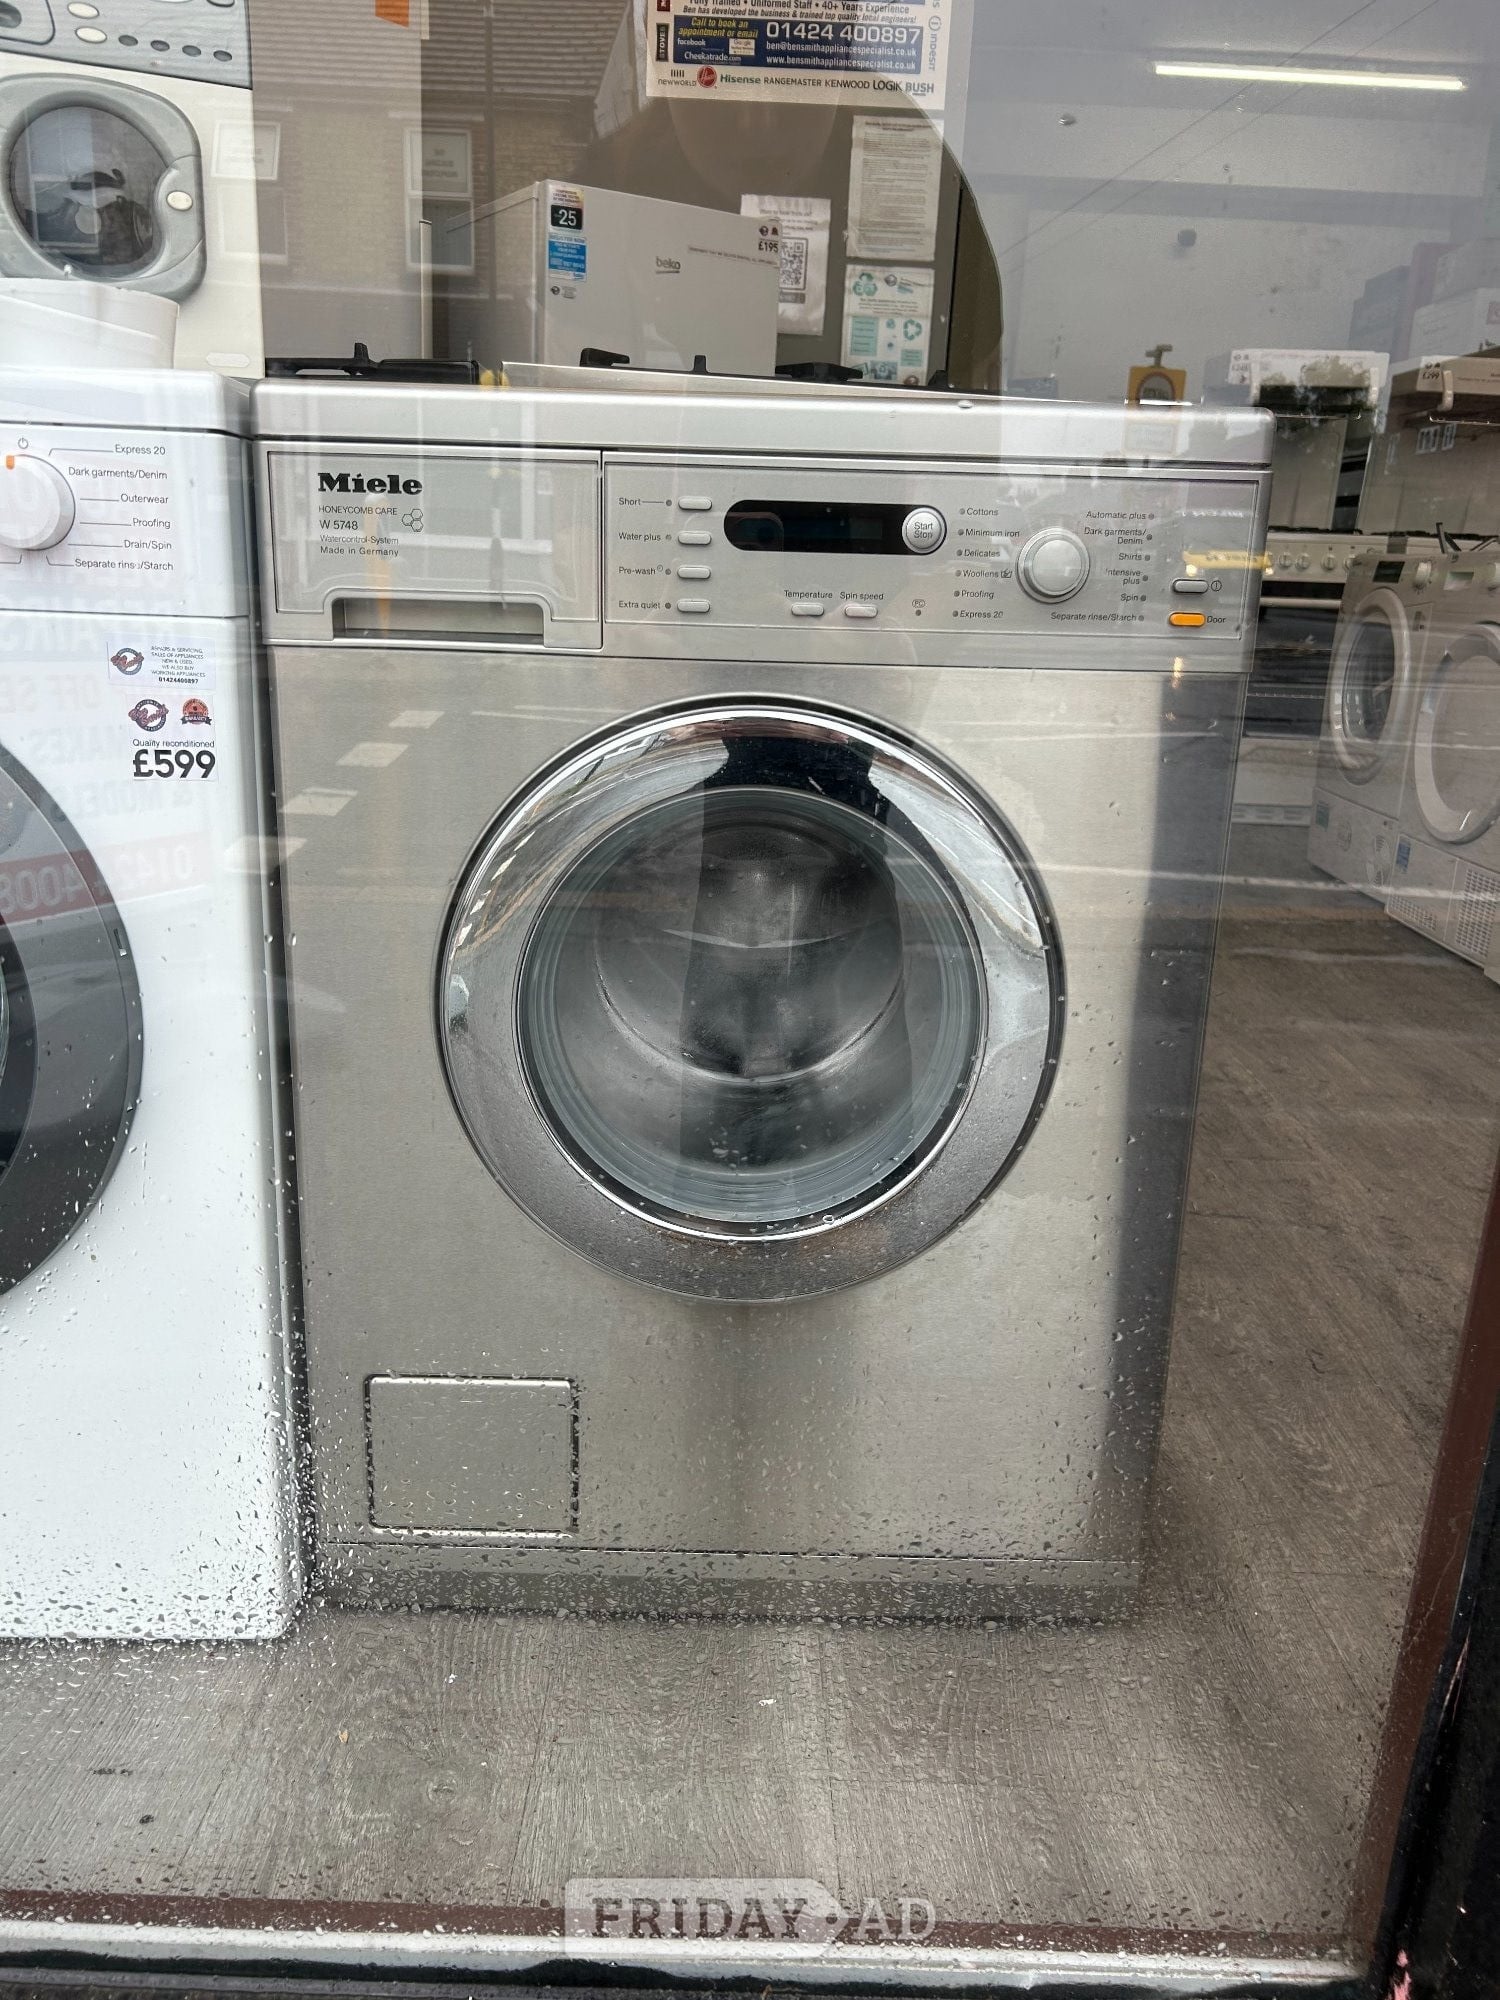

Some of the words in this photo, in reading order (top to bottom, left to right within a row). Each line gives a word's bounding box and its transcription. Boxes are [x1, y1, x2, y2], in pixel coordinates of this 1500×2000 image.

[751, 0, 791, 8] Uniformed
[794, 0, 812, 9] Staff
[822, 2, 838, 10] 40+
[842, 2, 863, 11] Years
[866, 4, 910, 14] Experience
[712, 7, 746, 16] developed
[760, 10, 790, 18] business
[800, 10, 824, 18] trained
[825, 12, 836, 20] top
[838, 12, 860, 22] quality
[691, 18, 706, 26] Call
[708, 18, 717, 26] to
[718, 19, 736, 28] book
[678, 27, 724, 36] appointment
[737, 29, 758, 38] email
[766, 22, 833, 40] 01424
[840, 24, 920, 44] 400897
[677, 38, 706, 46] facebook
[720, 74, 760, 84] Hisense
[764, 76, 822, 87] RANGEMASTER
[825, 79, 870, 89] KENWOOD
[873, 80, 902, 91] LOGIK
[906, 82, 934, 93] BUSH
[559, 209, 576, 226] 25
[758, 240, 778, 253] £195
[656, 256, 680, 270] beko
[115, 444, 152, 455] Express
[154, 446, 166, 455] 20
[69, 466, 90, 476] Dark
[92, 468, 168, 480] garments/Denim
[318, 472, 422, 496] Miele
[120, 494, 168, 504] Outerwear
[619, 498, 641, 506] Short
[318, 506, 373, 514] HONEYCOMB
[375, 507, 398, 516] CARE
[966, 508, 998, 516] Cottons
[1086, 510, 1126, 519] Automatic
[1129, 512, 1146, 520] plus
[133, 518, 170, 530] Proofing
[320, 520, 330, 529] W
[333, 520, 358, 530] 5748
[914, 522, 933, 530] Start
[914, 530, 932, 539] Stop
[966, 528, 1002, 536] Minimum
[1084, 526, 1102, 535] Dark
[1104, 528, 1146, 537] garments/
[320, 534, 398, 545] Watercontrol-System
[619, 532, 641, 540] Water
[644, 533, 661, 542] plus
[1118, 536, 1142, 544] Denim
[124, 540, 172, 551] Drain/Spin
[320, 546, 344, 554] Made
[360, 548, 398, 557] Germany
[964, 548, 1000, 558] Delicates
[1119, 552, 1142, 560] Shirts
[76, 559, 116, 570] Separate
[619, 566, 656, 575] Pre-wash
[964, 570, 998, 578] Woollens
[1122, 577, 1140, 586] plus
[784, 590, 832, 600] Temperature
[840, 592, 857, 600] Spin
[860, 592, 884, 600] speed
[961, 590, 994, 600] Proofing
[1120, 592, 1138, 602] Spin
[619, 600, 638, 608] Extra
[641, 601, 660, 610] quiet
[960, 610, 991, 619] Express
[1051, 612, 1086, 621] Separate
[132, 739, 160, 748] Quality
[162, 740, 214, 748] reconditioned
[132, 748, 216, 778] £599
